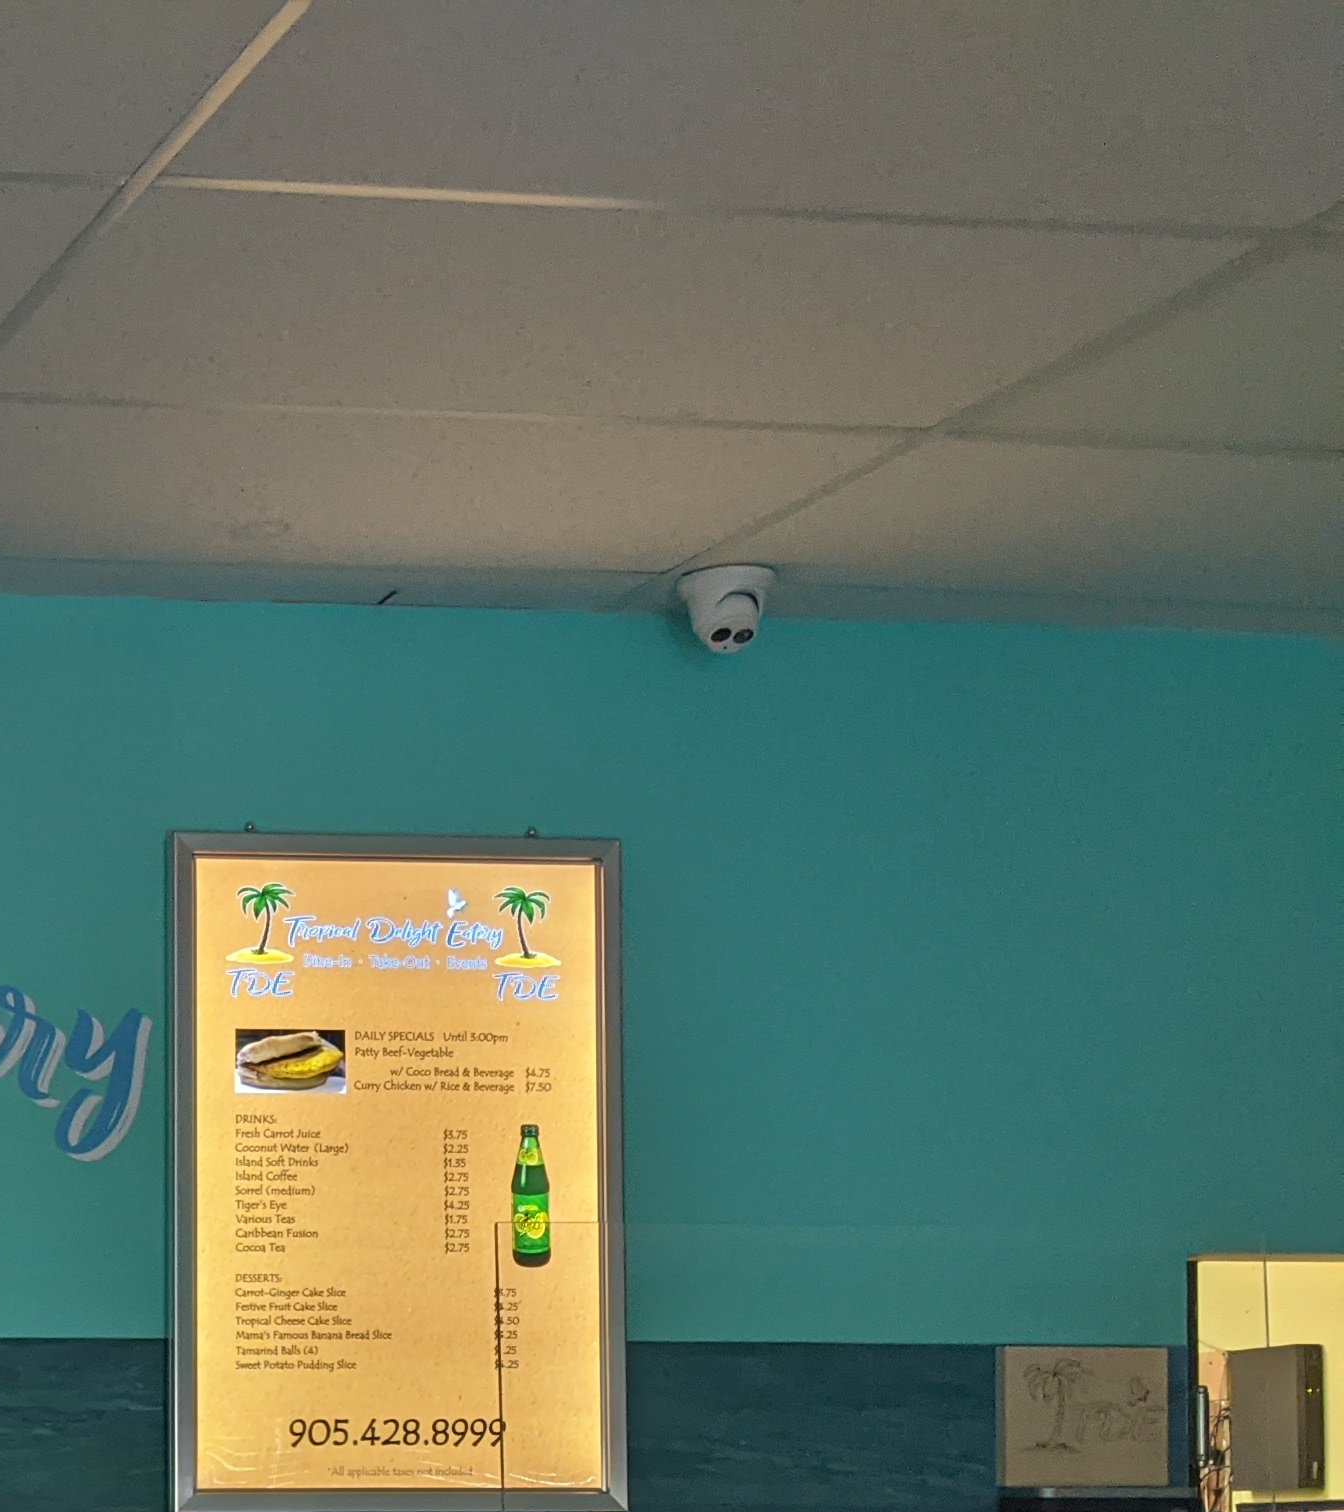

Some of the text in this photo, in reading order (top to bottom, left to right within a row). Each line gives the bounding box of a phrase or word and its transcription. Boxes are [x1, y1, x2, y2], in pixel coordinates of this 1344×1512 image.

[284, 916, 504, 950] Tropical Delight Eatery
[227, 969, 294, 997] TDE
[493, 973, 561, 1000] TDE
[354, 1030, 509, 1046] DAILY SPECIALS Until 3:00pm
[354, 1046, 455, 1061] Patty Beef-Vegetable
[389, 1066, 551, 1081] w/ Coco Bread & Beverage $4.75
[235, 1127, 468, 1142] Fresh Carrot Juice $3.75
[234, 1142, 469, 1157] Coconut Water (Large) $2.25
[234, 1198, 470, 1213] Tiger's Eye $4.25
[235, 1314, 353, 1328] Tropical Cheese Cake Slice
[235, 1344, 319, 1356] Tamarind Balls (4)
[288, 1418, 507, 1448] 905.428.8999
